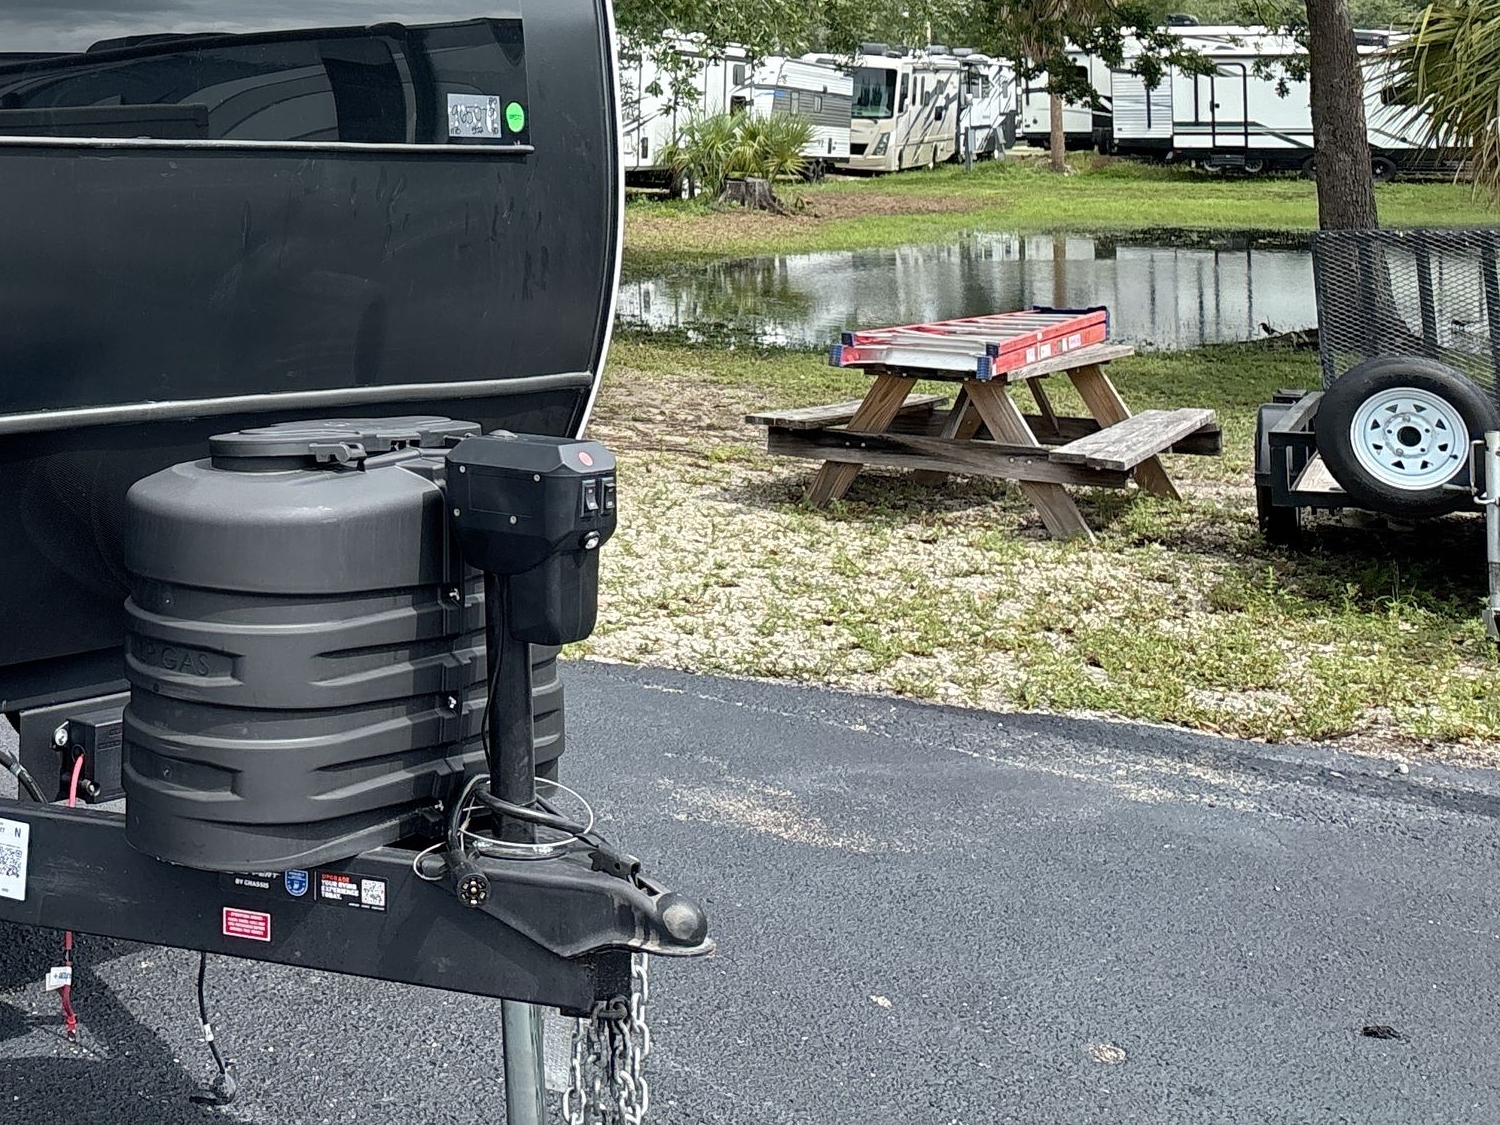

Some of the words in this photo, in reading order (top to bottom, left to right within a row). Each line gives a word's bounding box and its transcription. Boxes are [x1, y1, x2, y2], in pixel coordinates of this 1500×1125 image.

[162, 646, 211, 676] GAS
[14, 827, 21, 838] N
[244, 879, 270, 889] CHASSIS
[321, 885, 359, 897] EXPERIENCE
